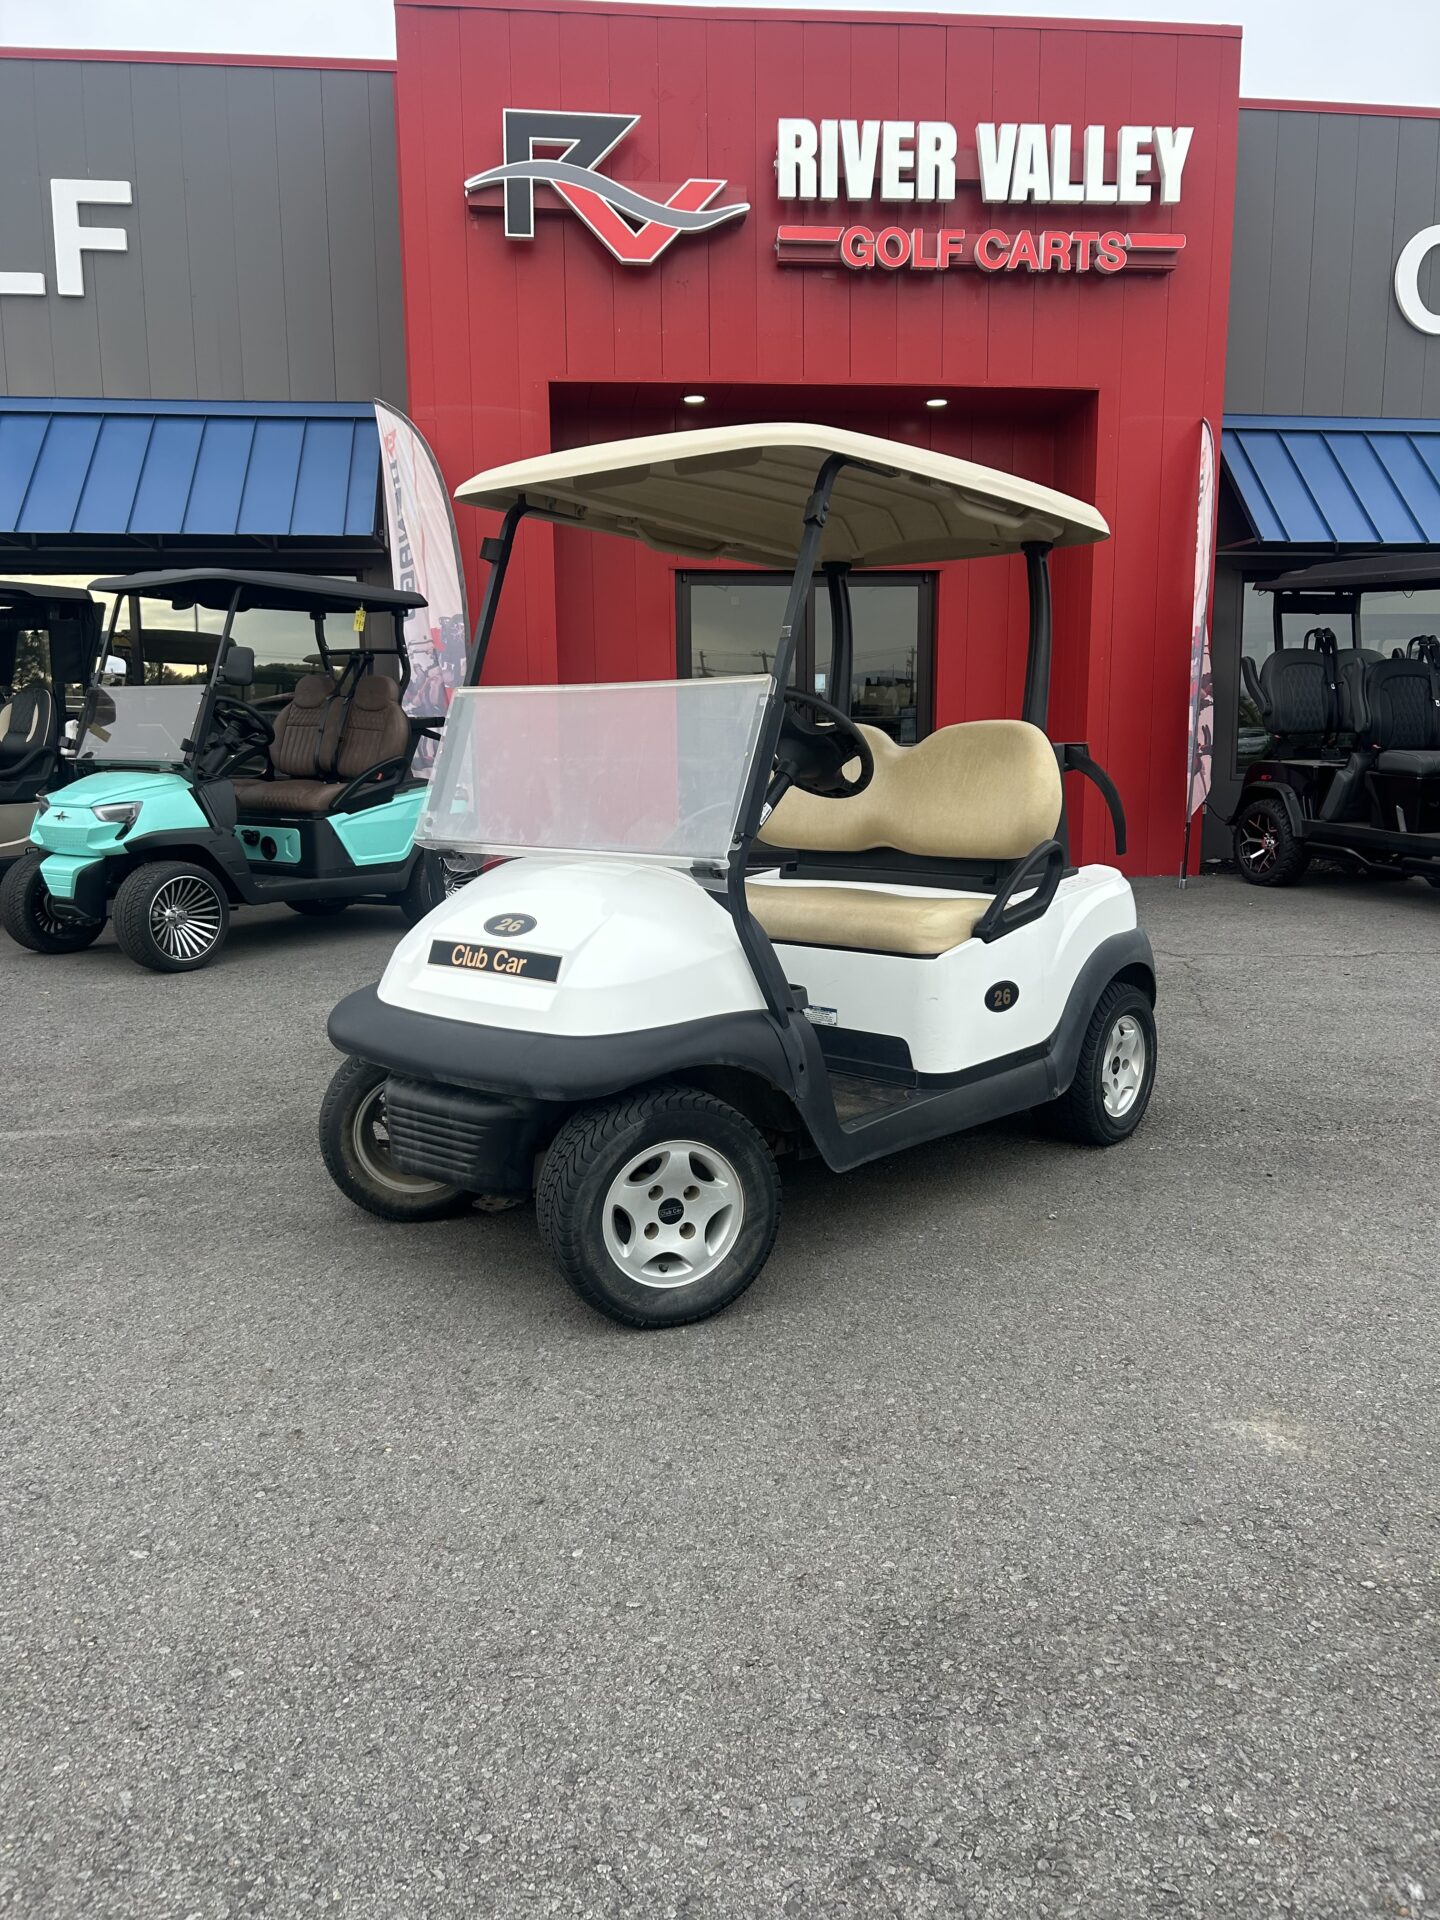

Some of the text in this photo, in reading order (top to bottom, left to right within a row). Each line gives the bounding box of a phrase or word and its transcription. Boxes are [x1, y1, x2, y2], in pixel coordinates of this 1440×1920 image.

[777, 117, 1195, 206] RIVER VALLEY
[840, 225, 1128, 274] GOLF CARTS
[494, 917, 525, 933] 26
[451, 944, 528, 974] Club Car
[993, 988, 1011, 1007] 26
